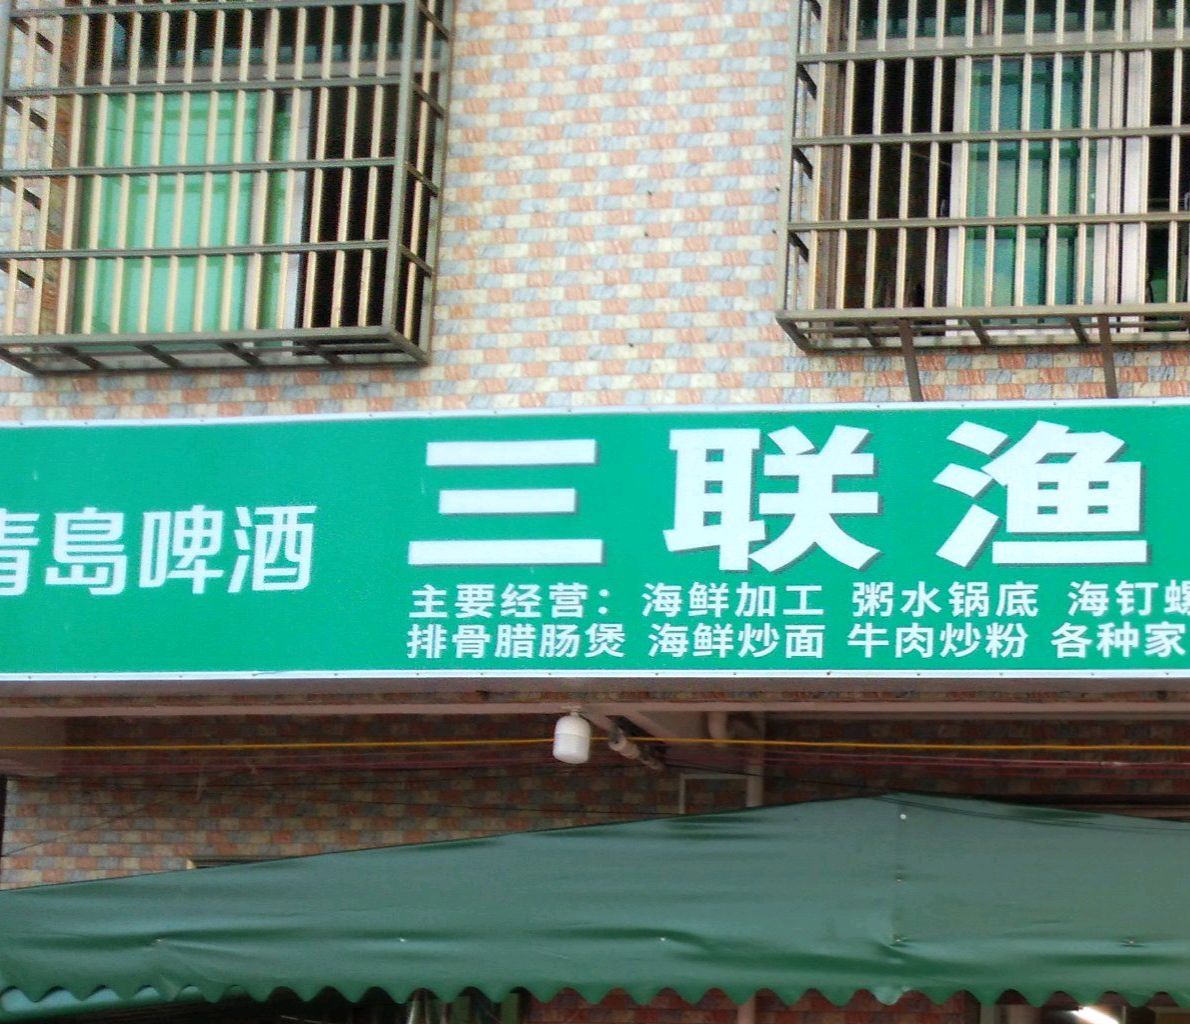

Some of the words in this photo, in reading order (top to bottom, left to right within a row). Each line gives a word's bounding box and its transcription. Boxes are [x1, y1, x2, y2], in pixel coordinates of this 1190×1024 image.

[641, 582, 824, 618] 海鲜加工
[851, 581, 1039, 618] 粥水锅底
[407, 623, 625, 659] 排骨腊肠煲
[648, 622, 826, 659] 海鲜炒面
[847, 621, 1029, 659] 牛肉炒粉
